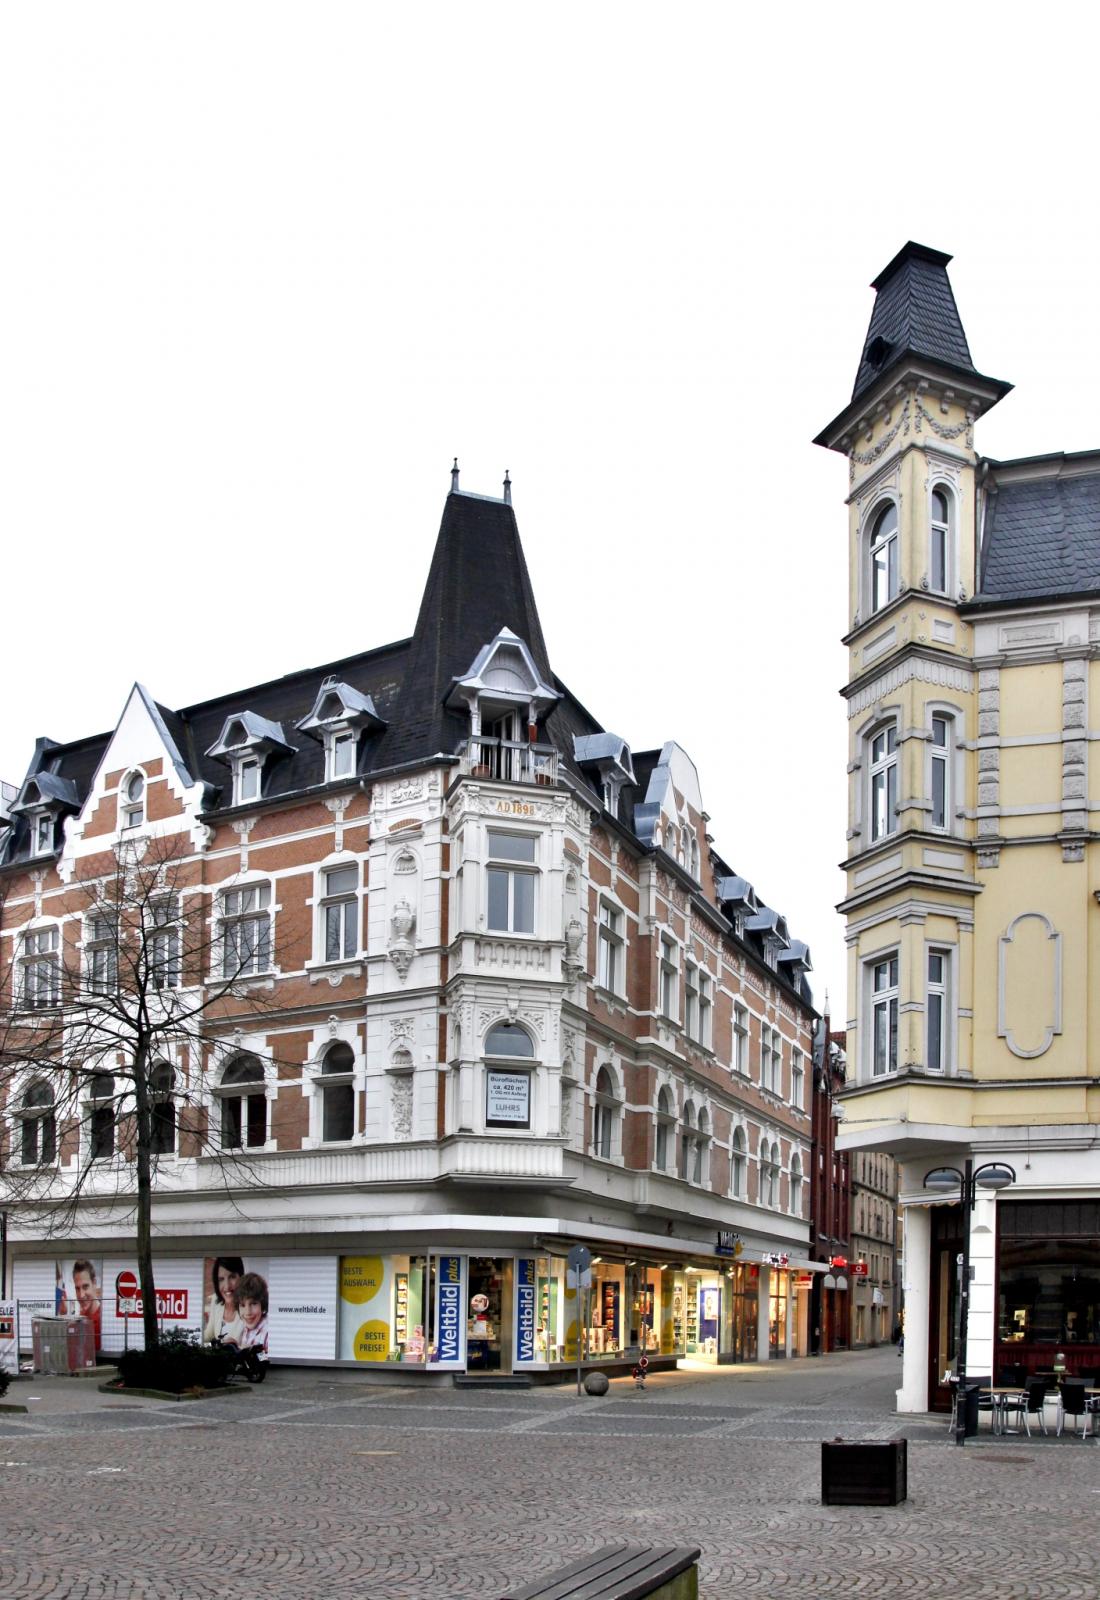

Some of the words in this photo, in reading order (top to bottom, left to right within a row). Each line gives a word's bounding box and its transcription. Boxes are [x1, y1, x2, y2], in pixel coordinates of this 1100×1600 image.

[343, 1266, 363, 1275] BESTE
[446, 1258, 460, 1283] plus
[525, 1261, 535, 1285] plus
[343, 1279, 376, 1287] AUSWAHL
[278, 1305, 327, 1313] www.weltbild.de
[441, 1286, 458, 1358] Weltbild
[520, 1288, 533, 1359] Weltbild
[364, 1331, 386, 1340] BESTE
[359, 1343, 385, 1352] PREISE!
